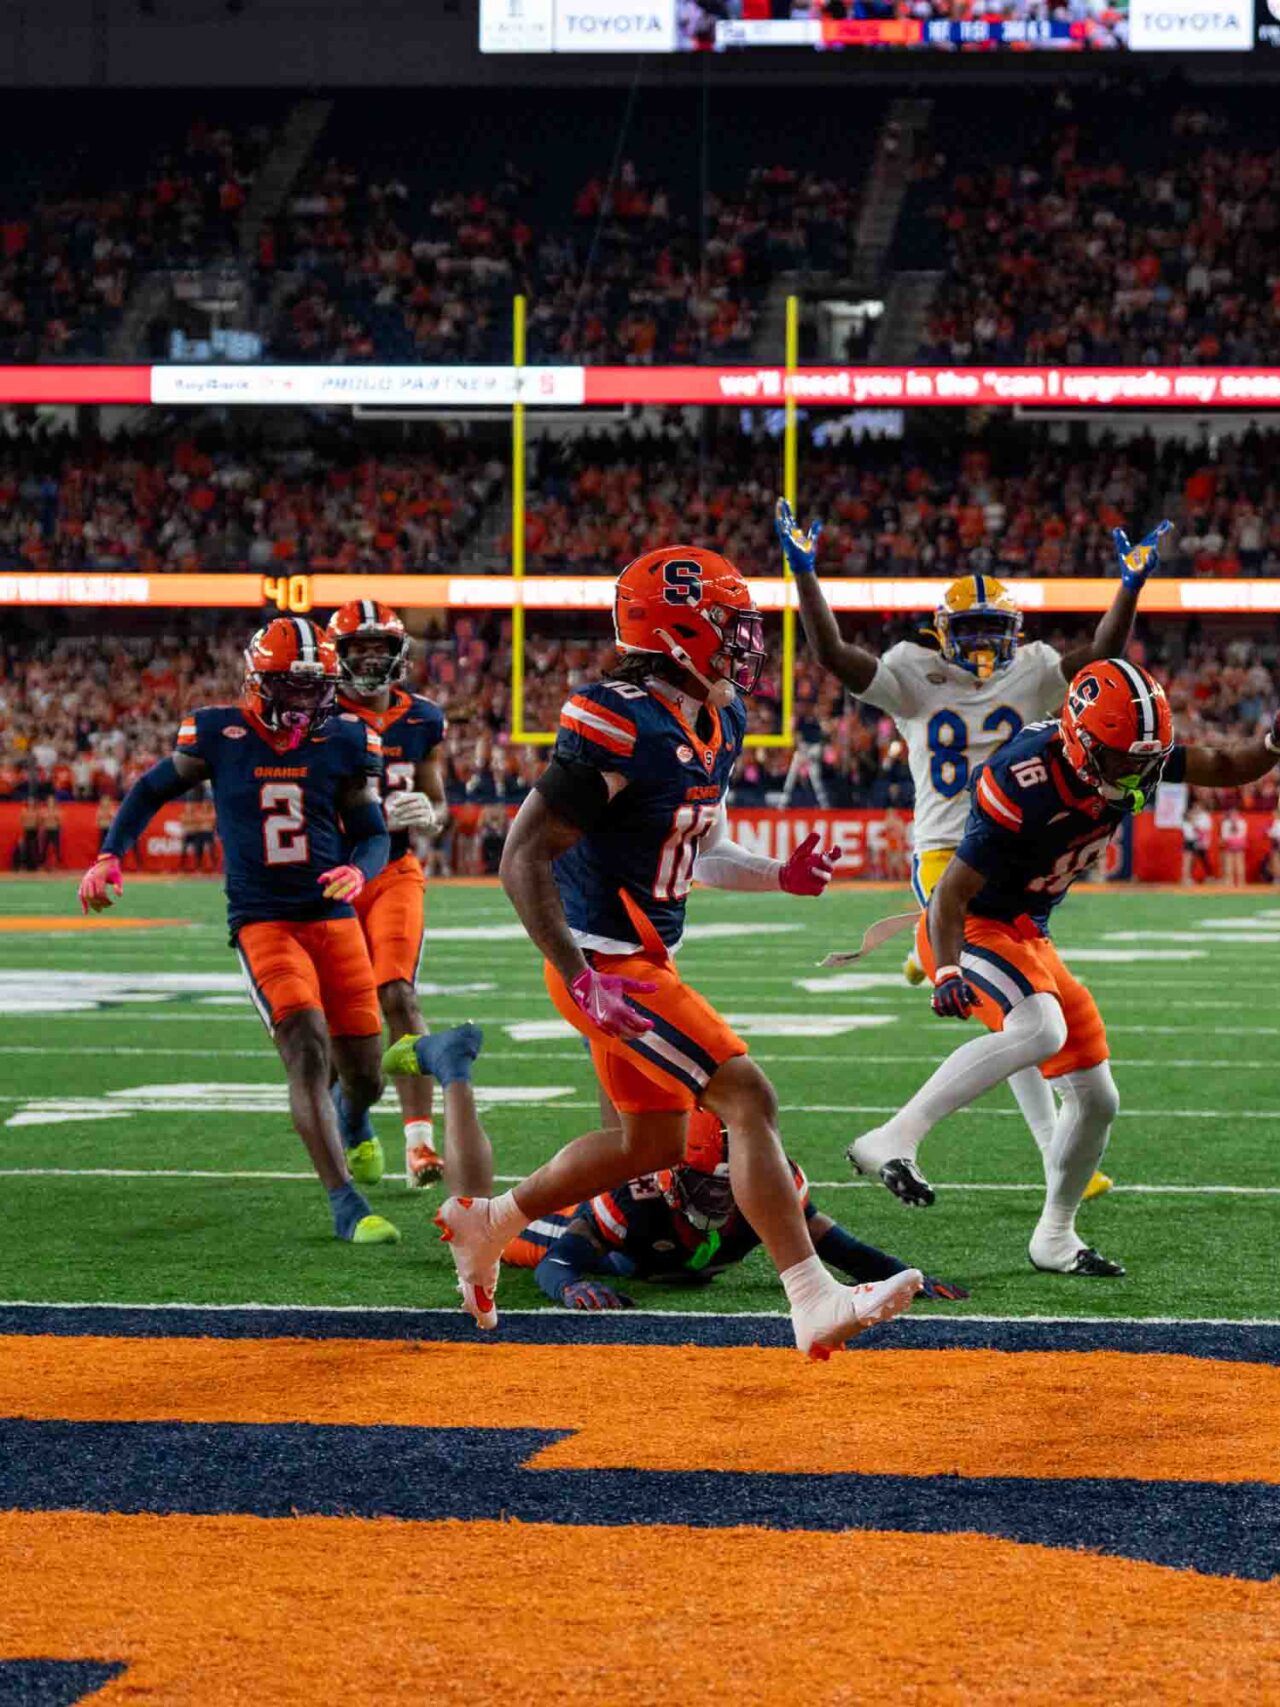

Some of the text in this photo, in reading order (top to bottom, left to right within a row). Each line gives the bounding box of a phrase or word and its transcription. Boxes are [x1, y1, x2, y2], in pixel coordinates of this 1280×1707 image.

[566, 15, 662, 32] TOYOTA
[1144, 14, 1240, 31] TOYOTA
[720, 371, 780, 395] we'll
[784, 373, 850, 396] meet
[854, 376, 902, 400] you
[907, 371, 931, 395] in
[936, 371, 978, 396] the
[1049, 372, 1059, 395] I
[1064, 372, 1170, 401] upgrade
[1175, 376, 1216, 400] my
[264, 575, 310, 612] 40
[663, 560, 703, 606] S
[254, 766, 308, 778] ORANGE
[1009, 757, 1048, 788] 16
[260, 782, 310, 865] 2
